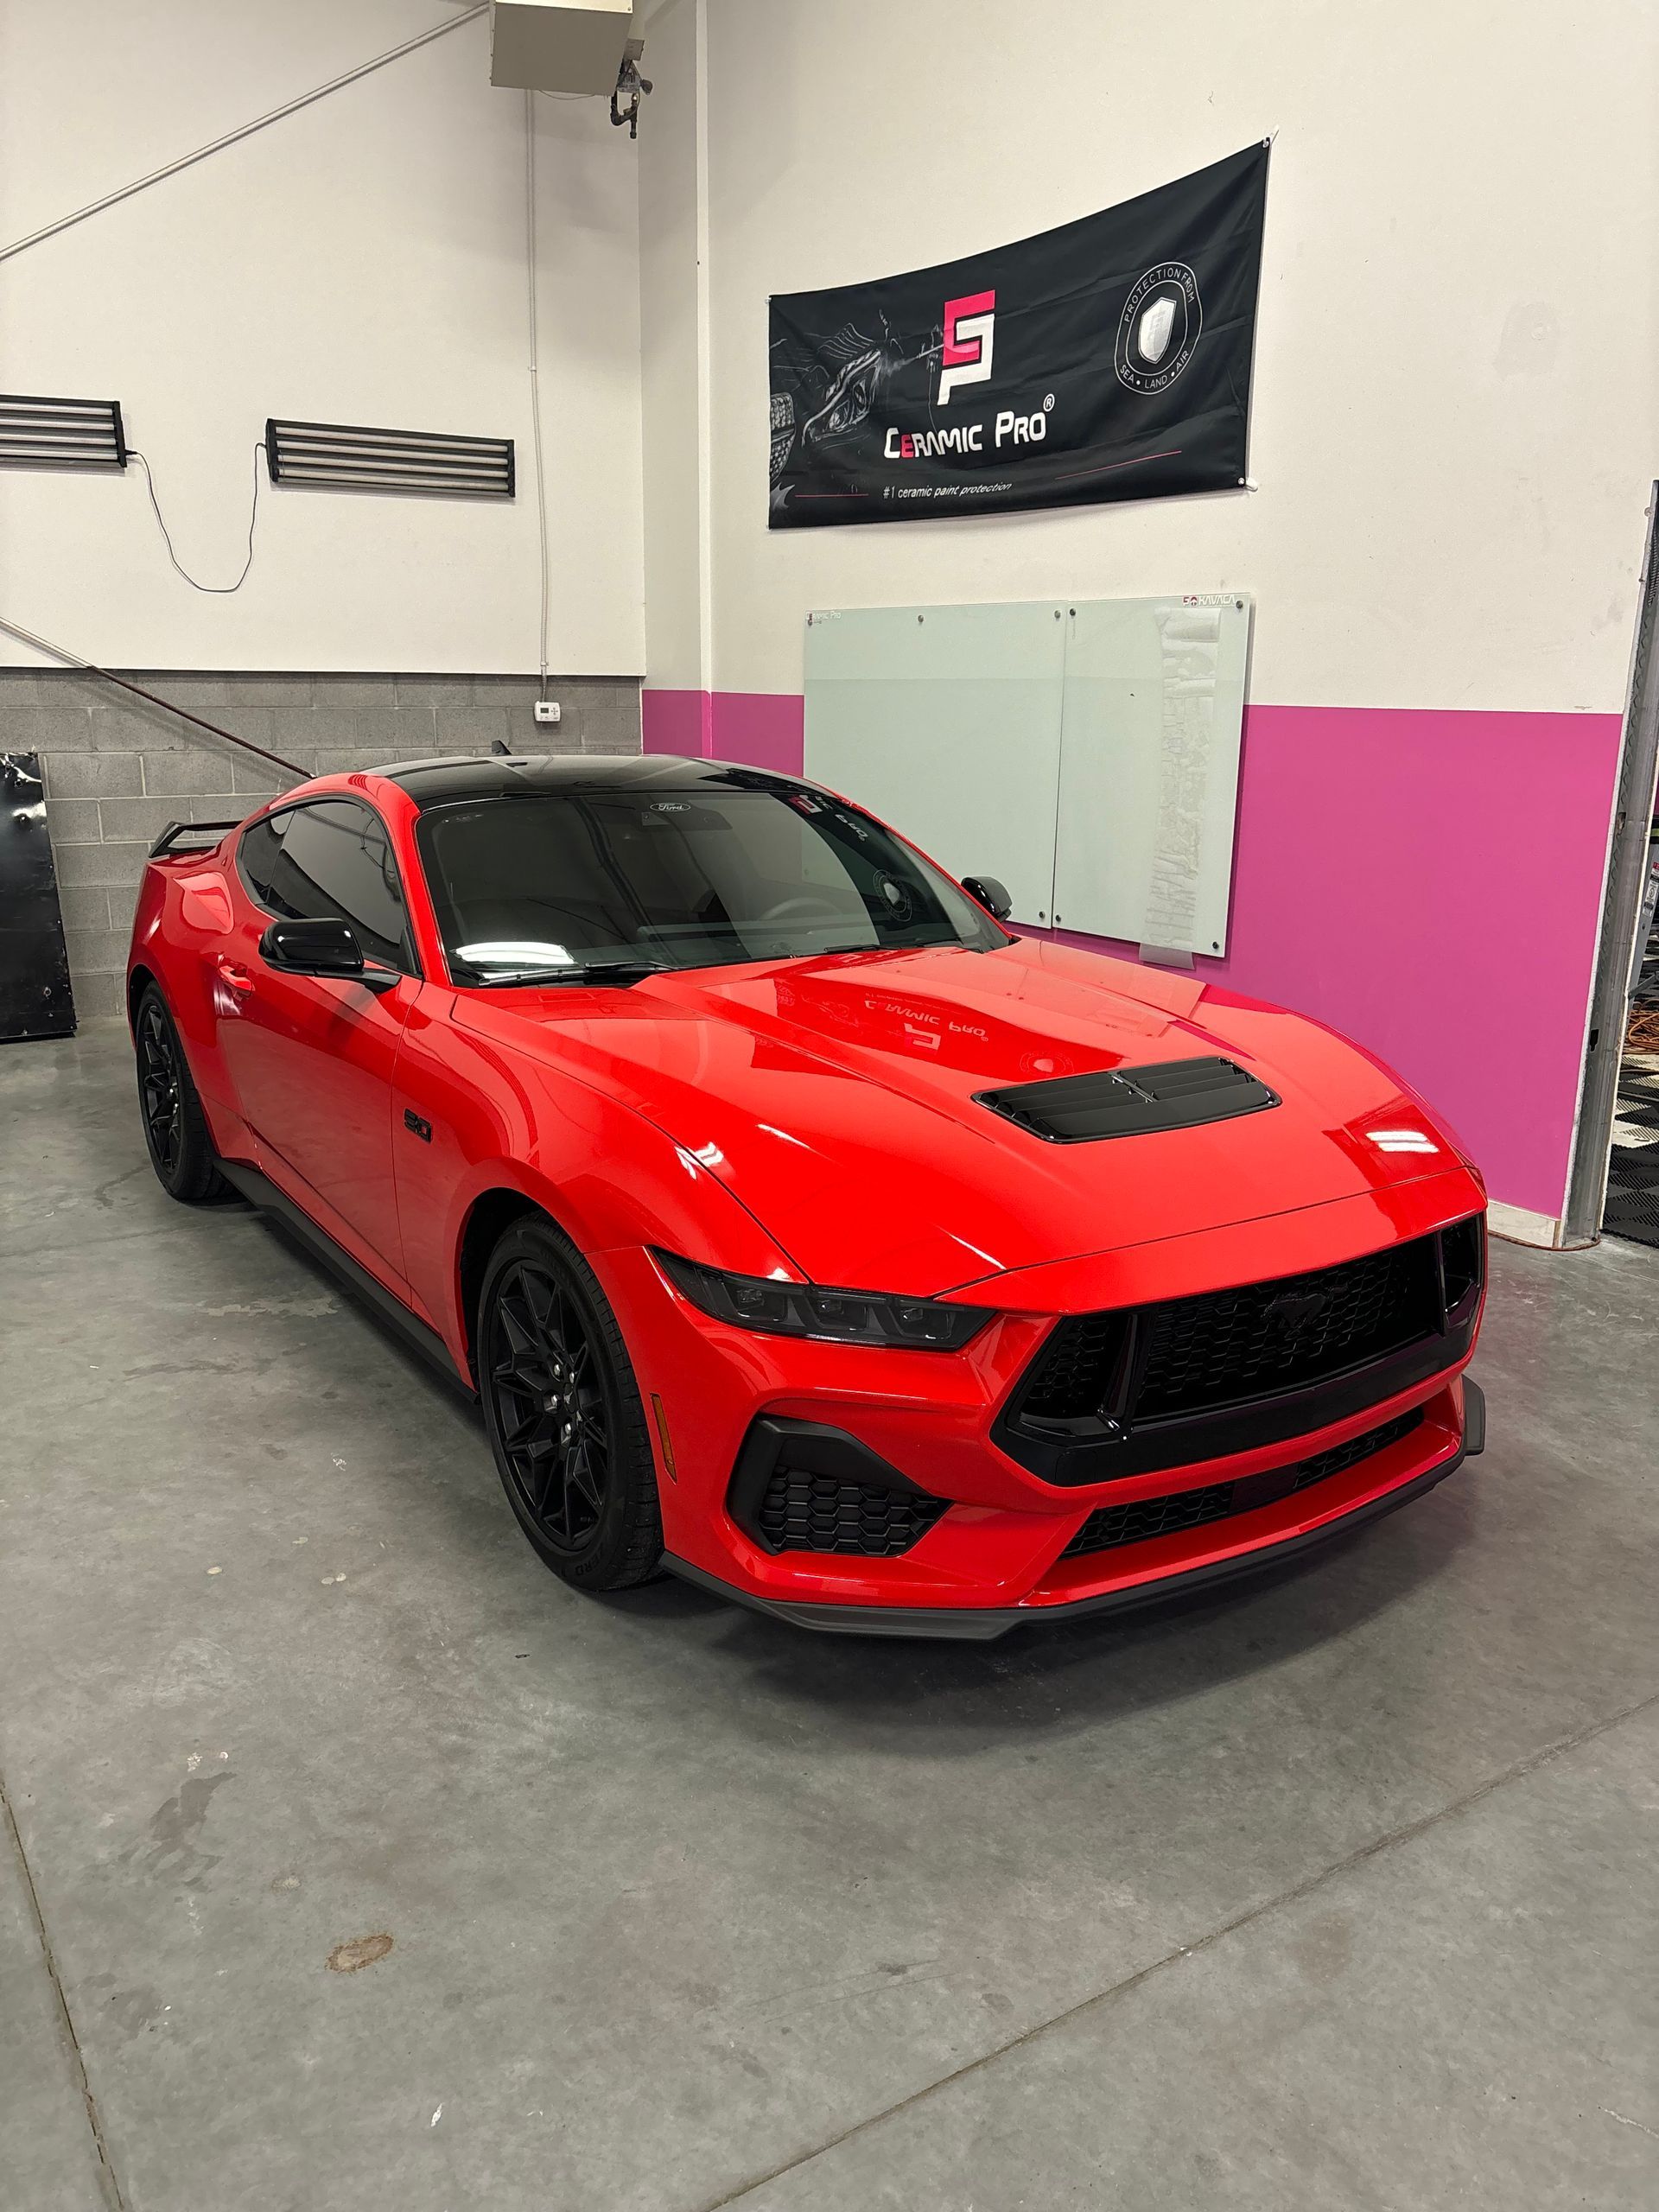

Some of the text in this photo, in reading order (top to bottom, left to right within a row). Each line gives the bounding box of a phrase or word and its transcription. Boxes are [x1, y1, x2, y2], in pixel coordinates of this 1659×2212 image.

[1124, 267, 1195, 322] PROTECTION FROM
[1120, 350, 1190, 389] SEA LAND AIR
[882, 481, 1013, 499] #1 ceramic paint protection
